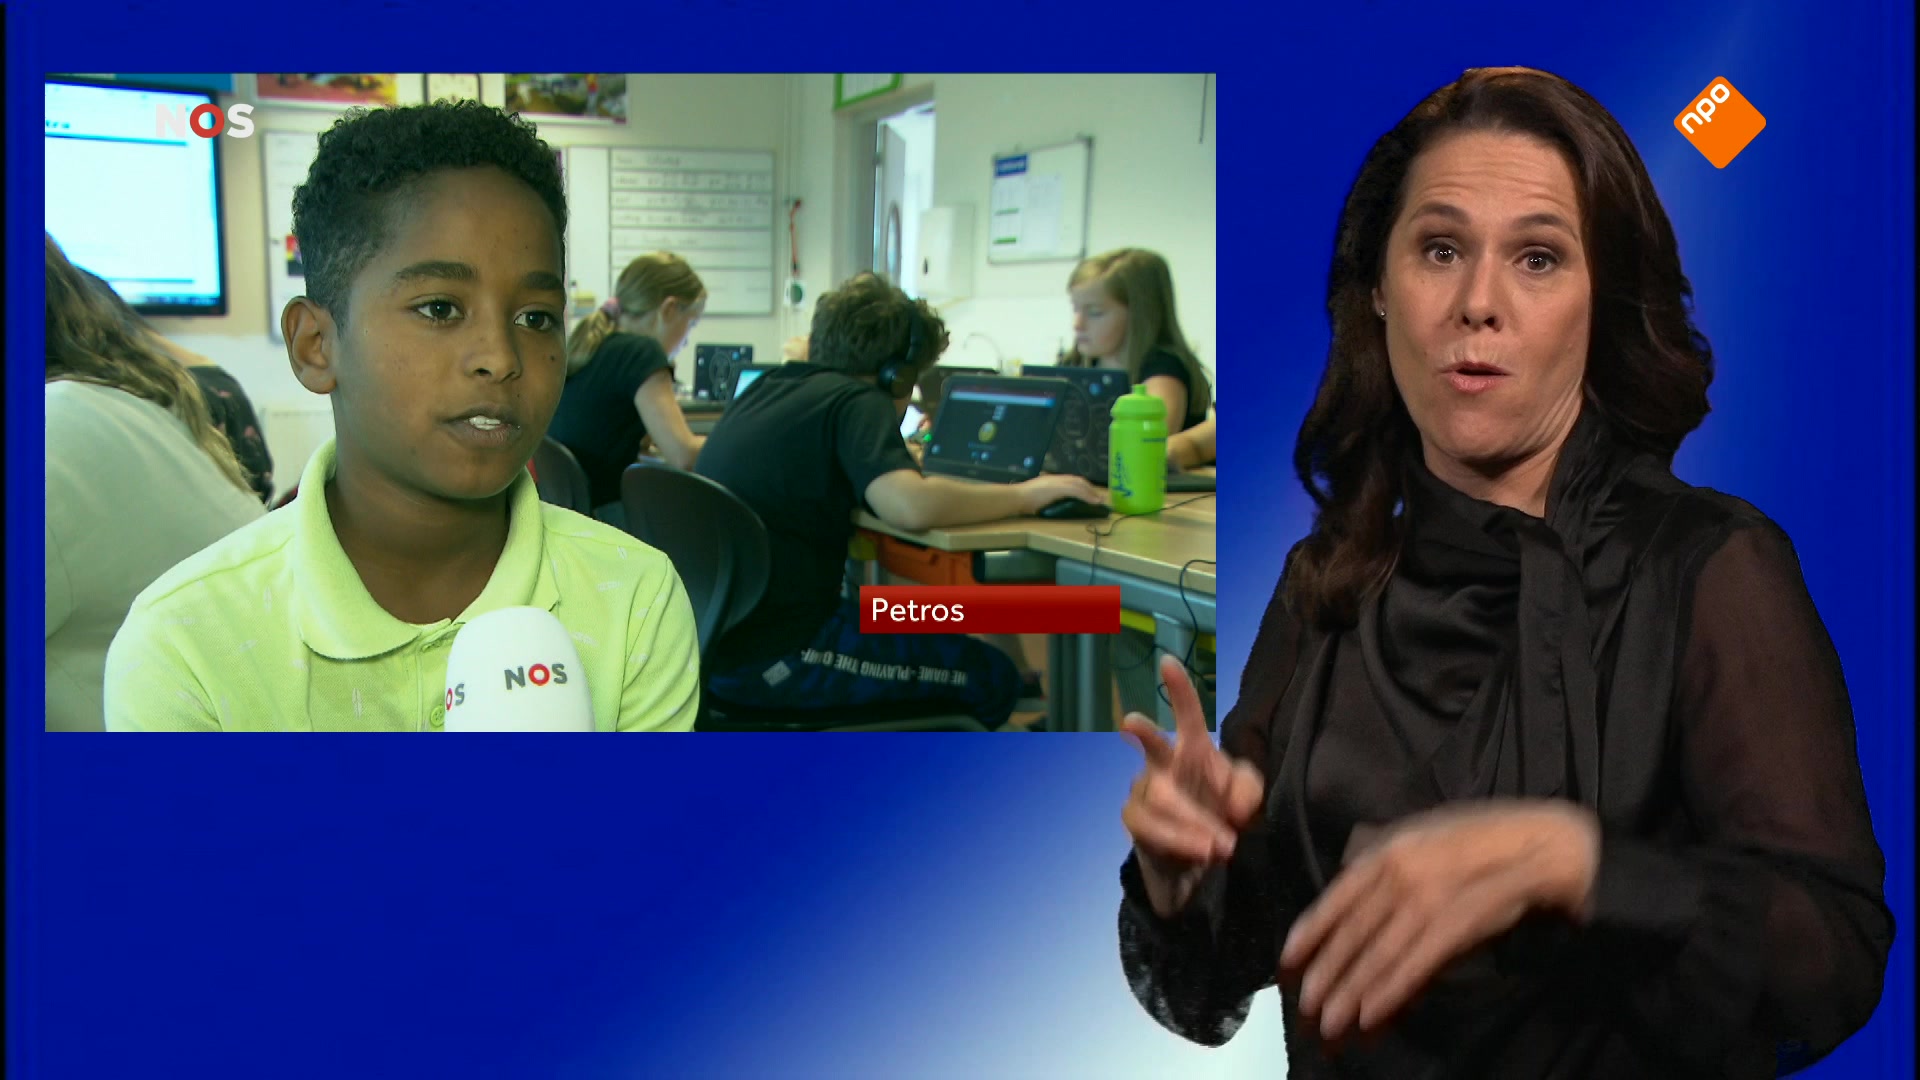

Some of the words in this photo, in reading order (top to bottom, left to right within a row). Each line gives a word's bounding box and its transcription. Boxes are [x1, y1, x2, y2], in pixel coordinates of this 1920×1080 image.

[504, 663, 568, 690] NOS
[834, 653, 859, 674] THE
[446, 683, 465, 711] OS
